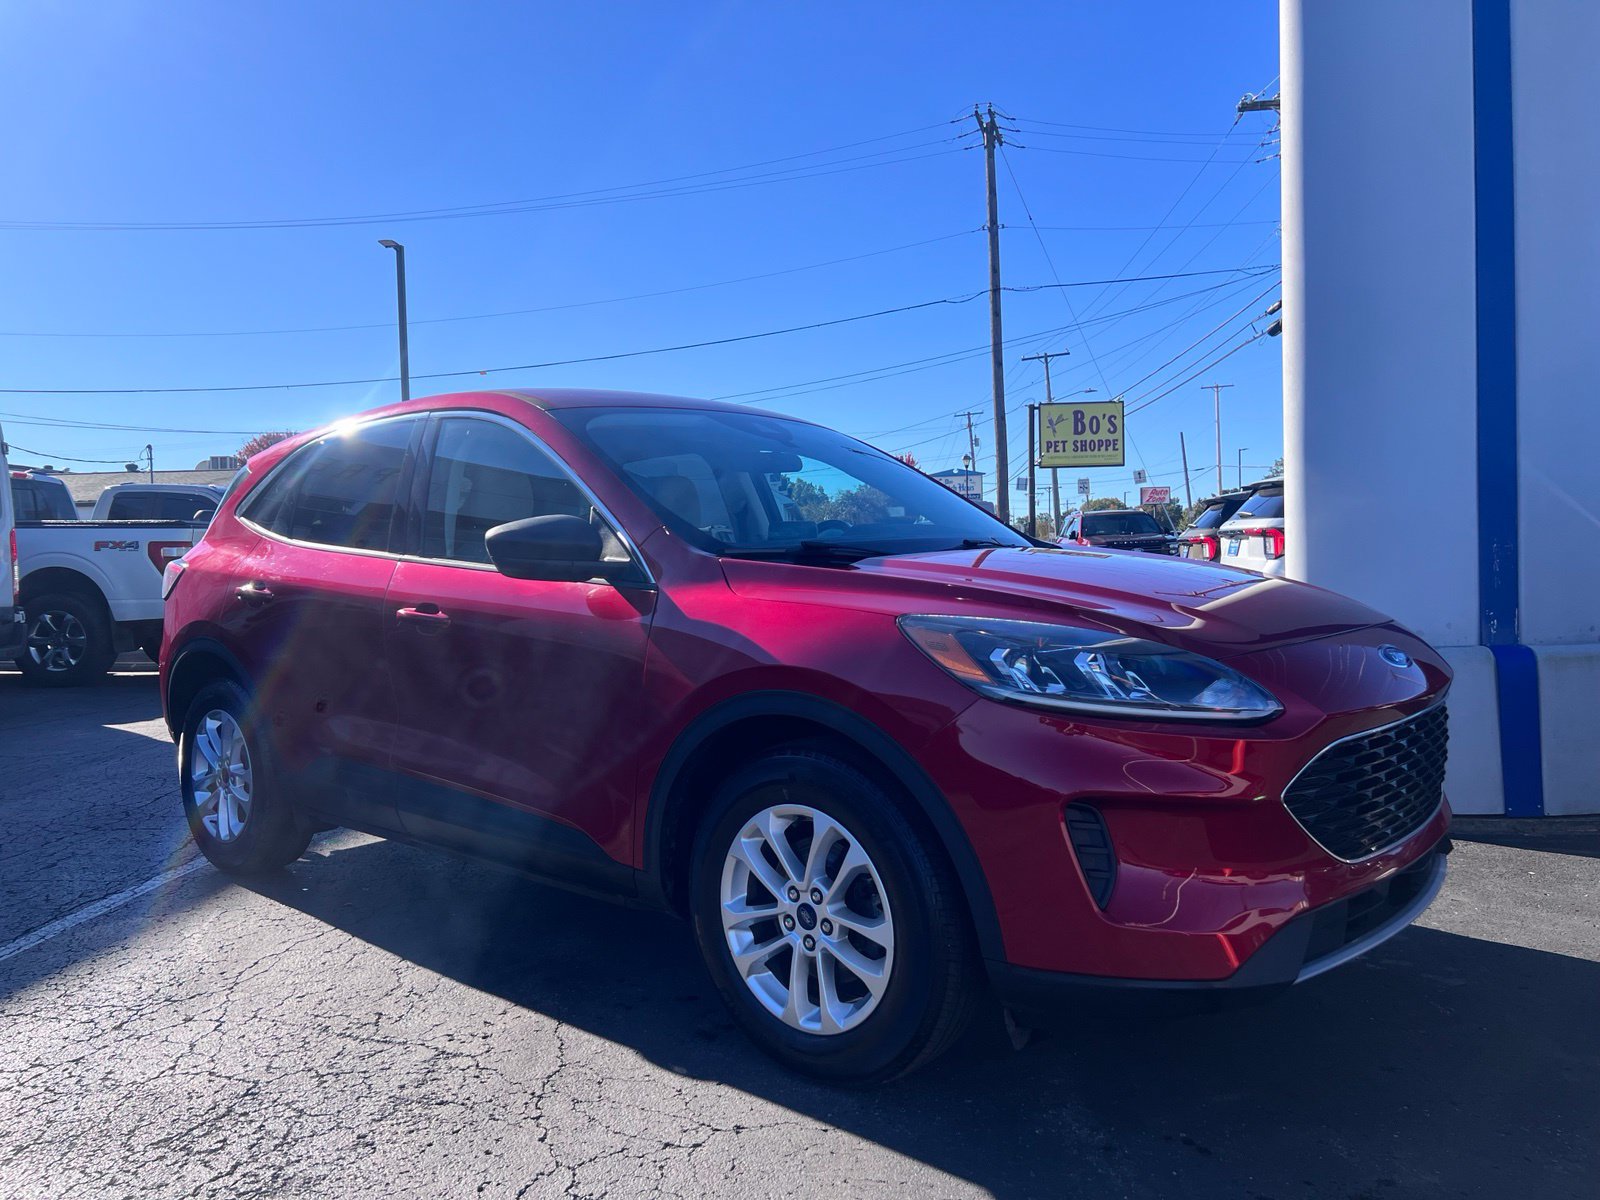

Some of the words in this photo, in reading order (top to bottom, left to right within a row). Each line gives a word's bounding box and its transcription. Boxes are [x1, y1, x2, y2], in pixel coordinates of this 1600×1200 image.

[1046, 440, 1068, 453] PET
[1072, 438, 1119, 453] SHOPPE
[94, 541, 139, 552] FX4
